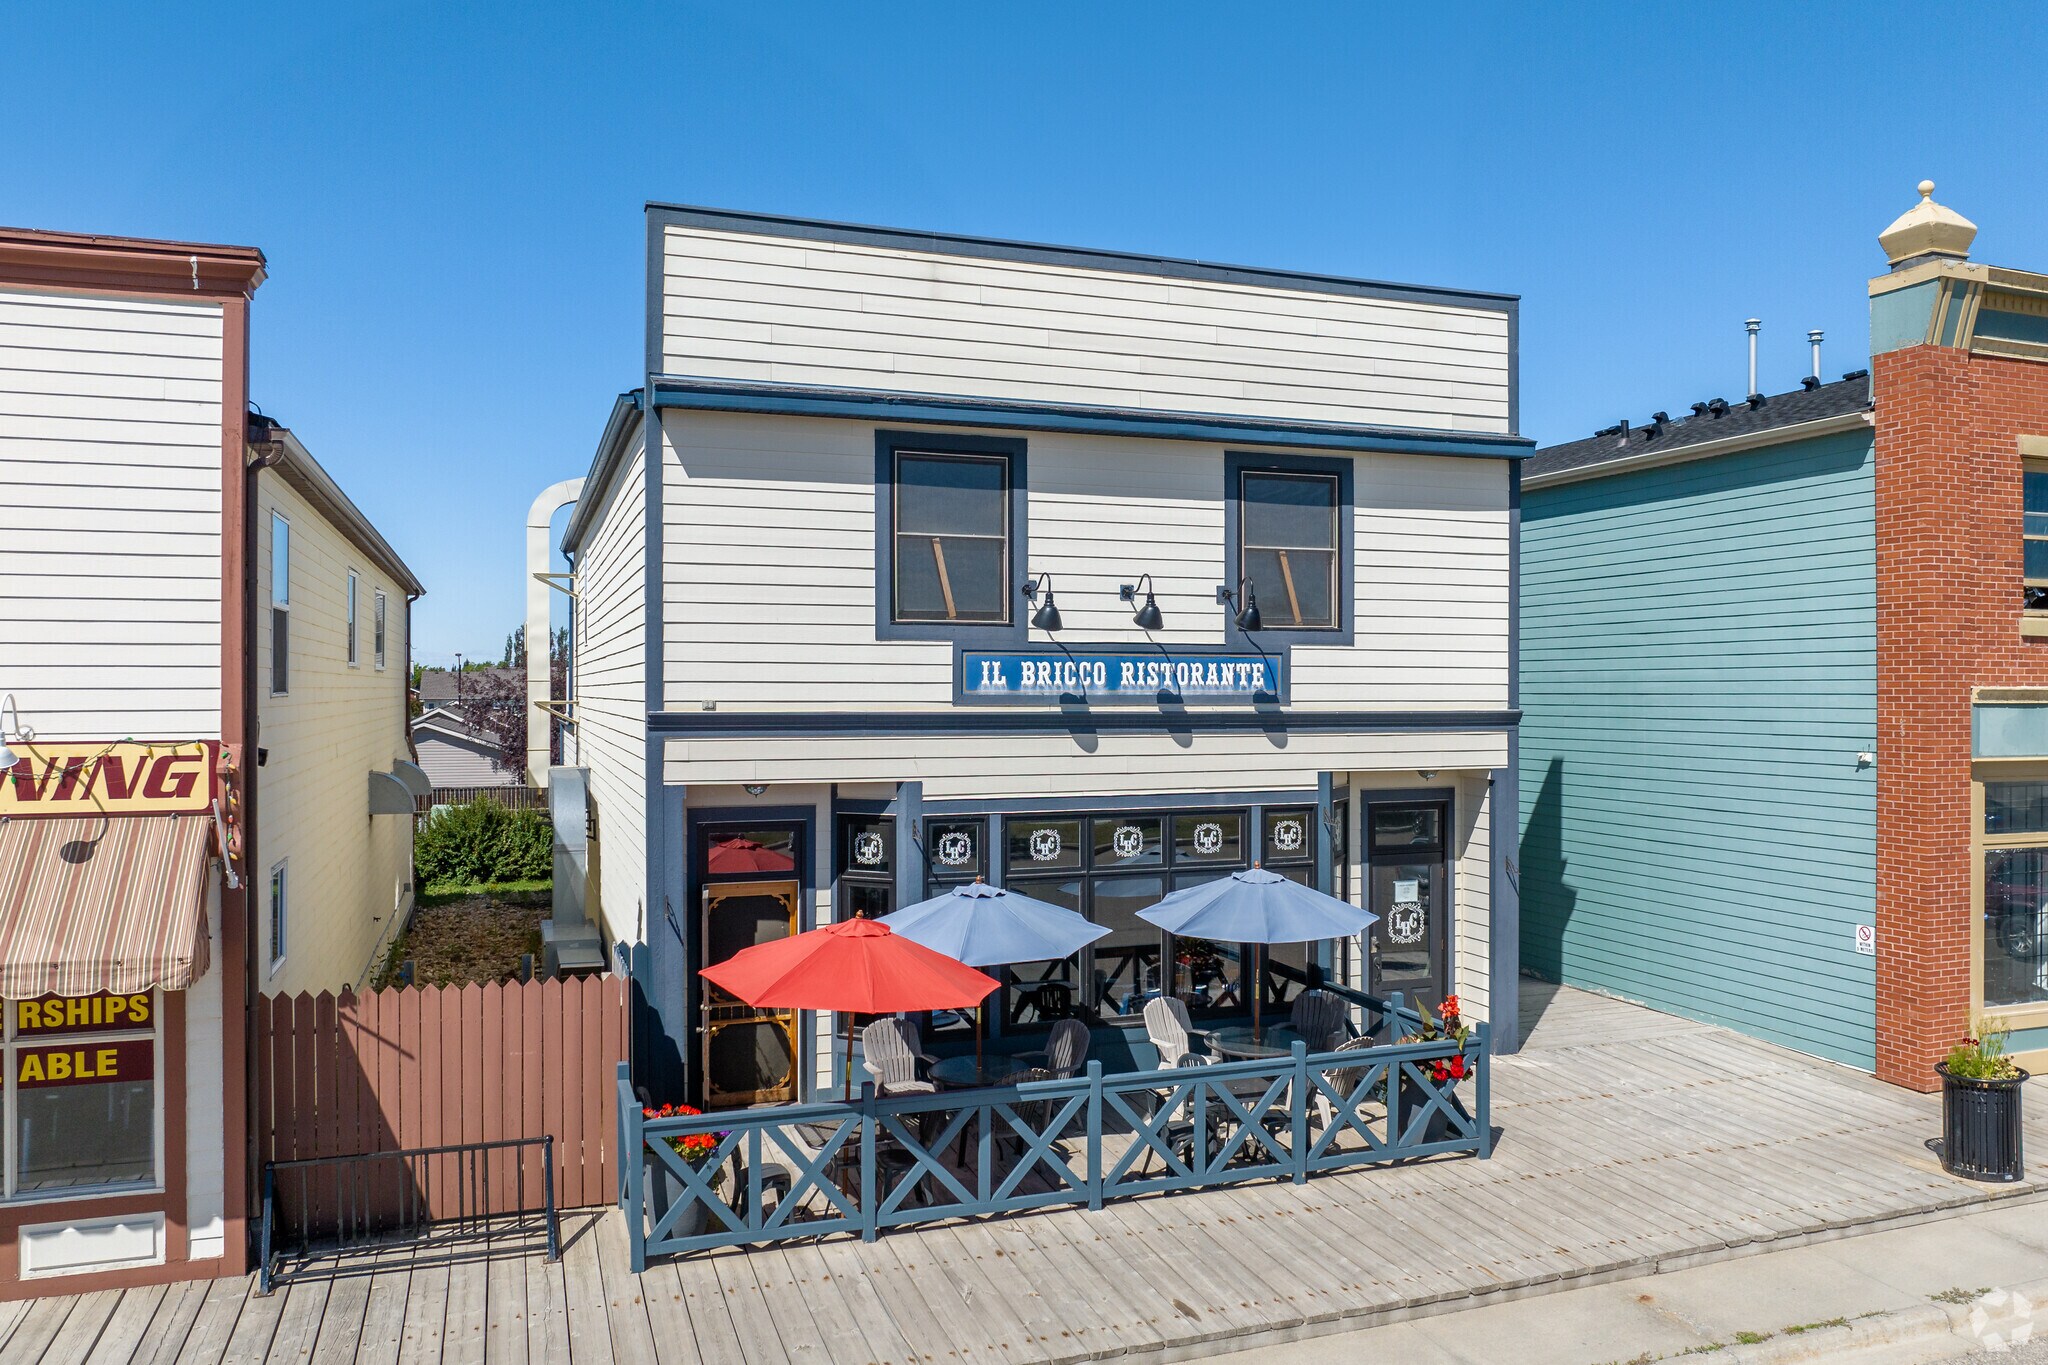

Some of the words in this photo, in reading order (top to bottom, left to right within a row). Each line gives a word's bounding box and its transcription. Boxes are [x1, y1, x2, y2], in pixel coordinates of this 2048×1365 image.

[981, 660, 1006, 687] IL
[1020, 661, 1106, 687] BRICCO
[1120, 662, 1264, 687] RISTORANTE
[18, 994, 149, 1029] RSHIPS
[18, 1049, 118, 1082] ABLE
